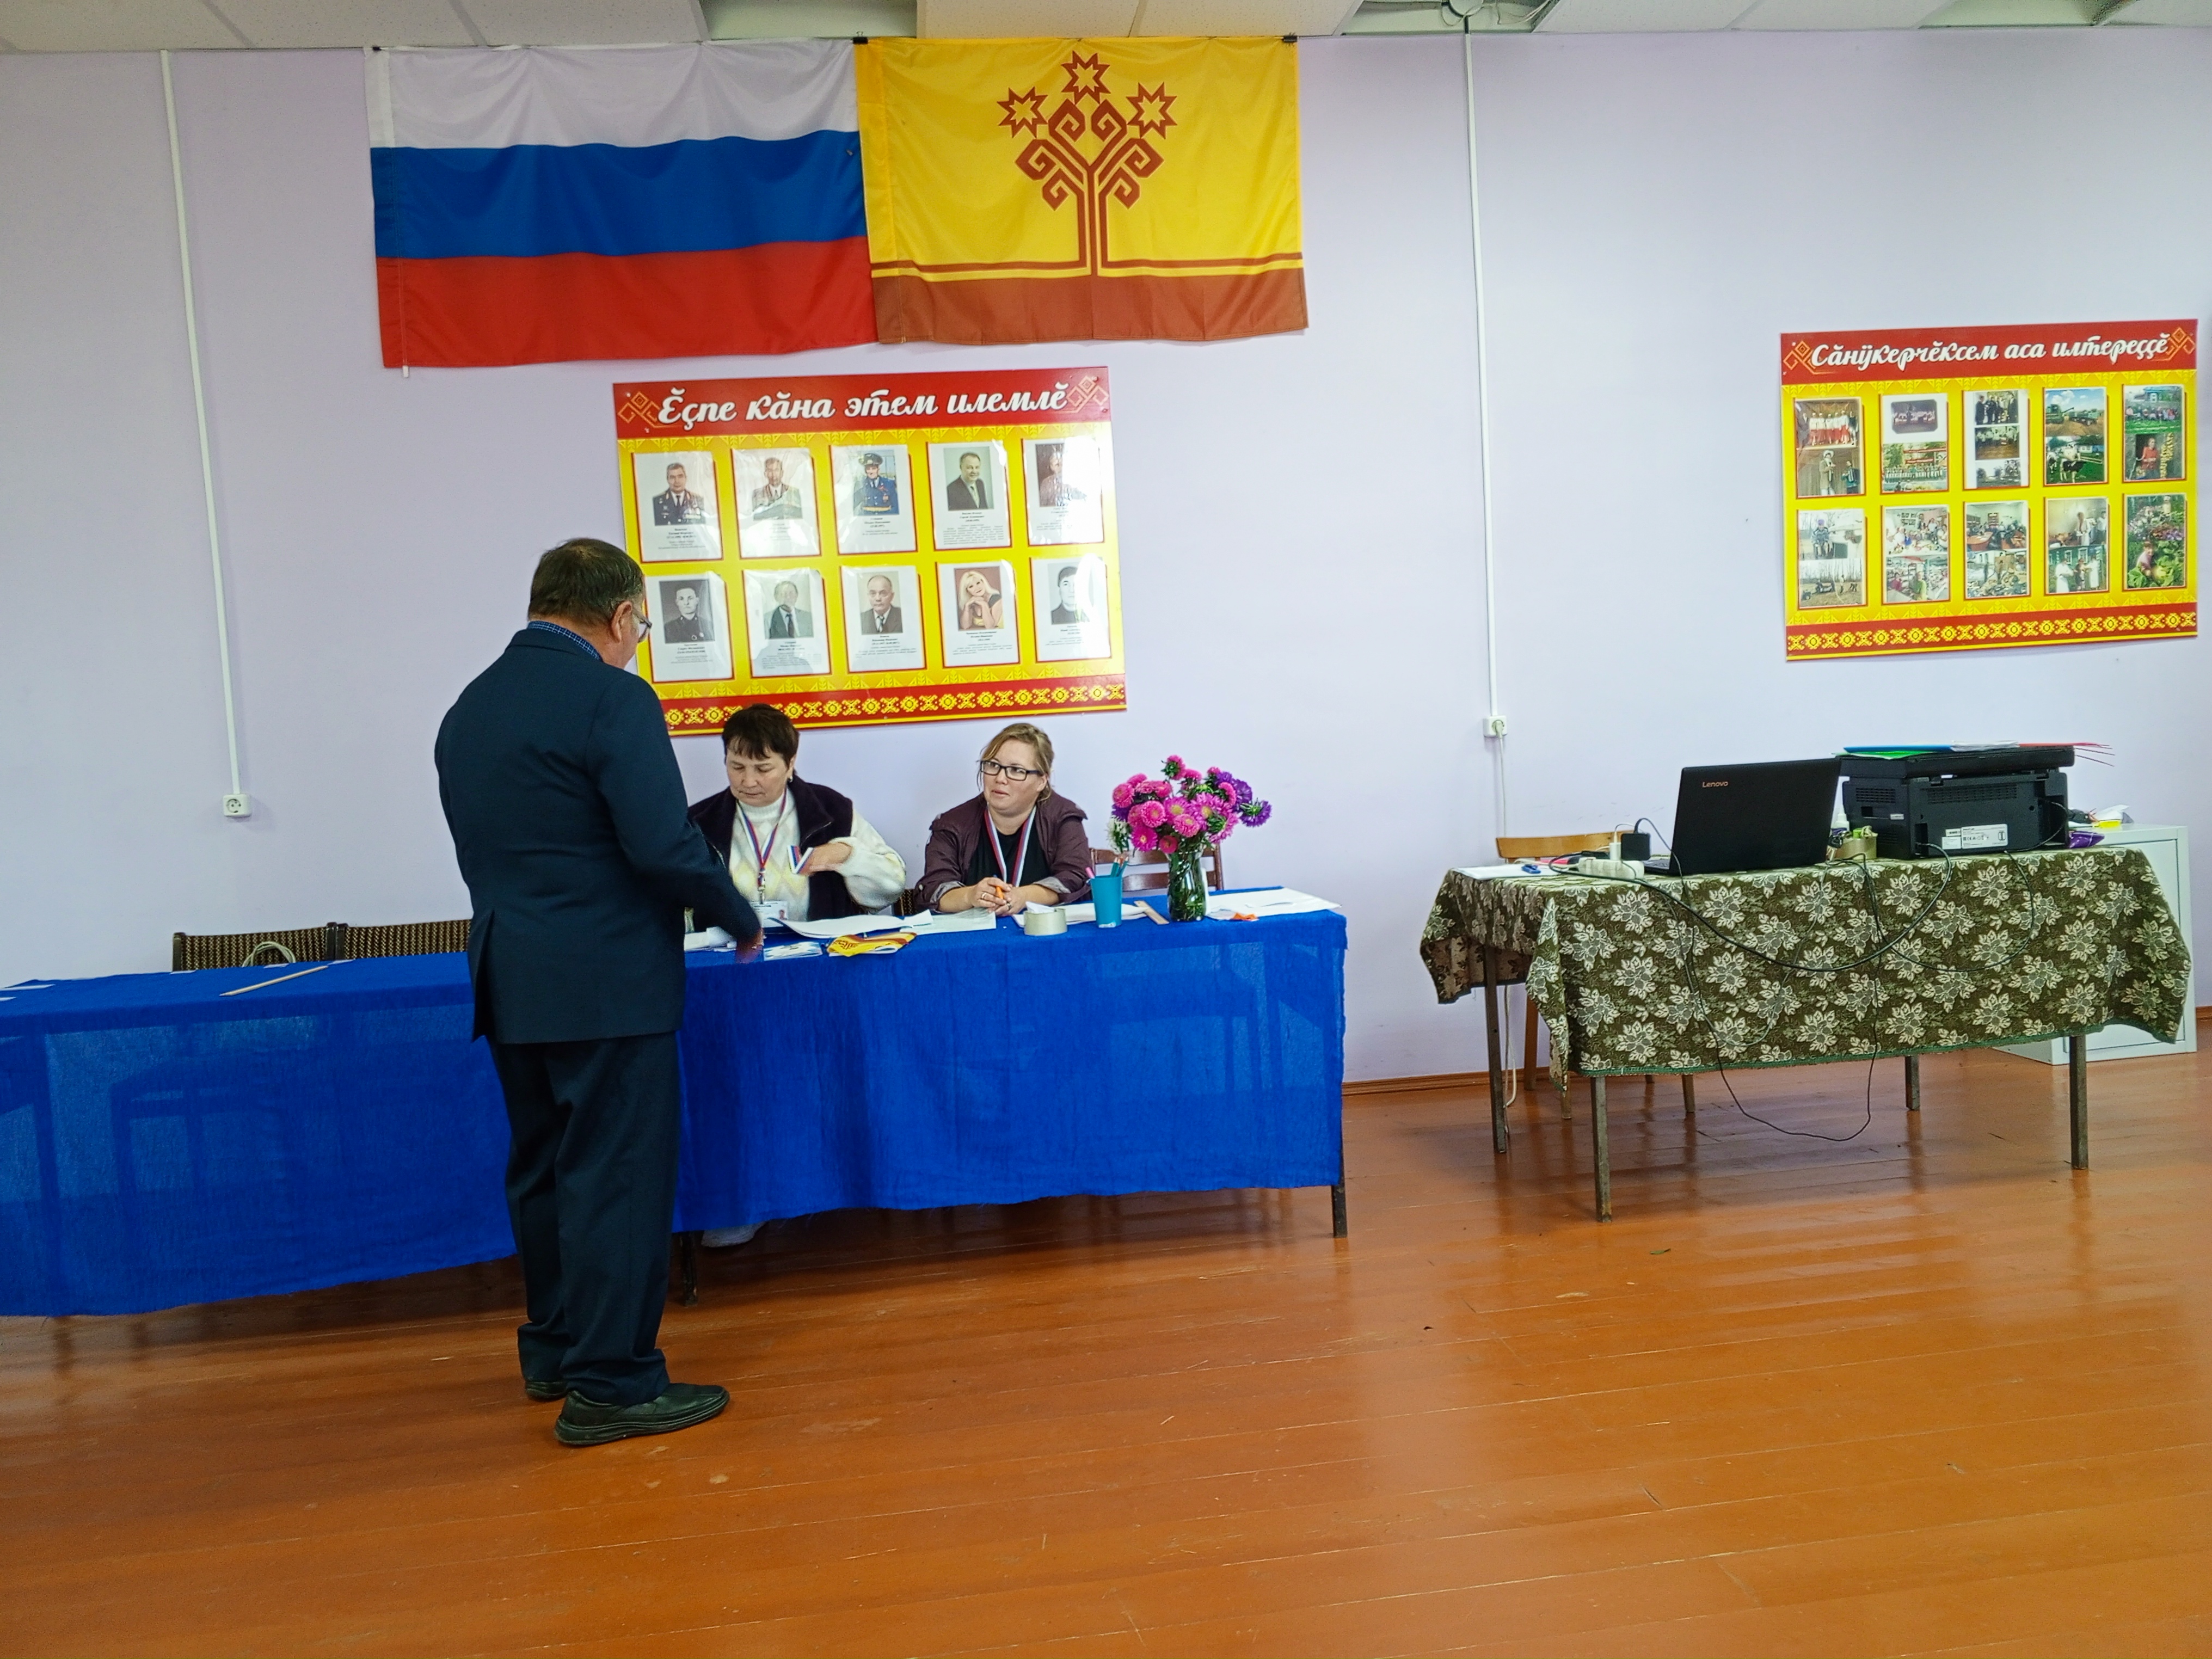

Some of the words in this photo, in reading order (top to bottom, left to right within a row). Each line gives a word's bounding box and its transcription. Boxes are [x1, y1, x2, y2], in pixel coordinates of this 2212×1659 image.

[2004, 343, 2047, 359] аса
[745, 391, 836, 421] кӑна
[844, 389, 938, 417] этем
[947, 382, 1069, 414] илемлӗ
